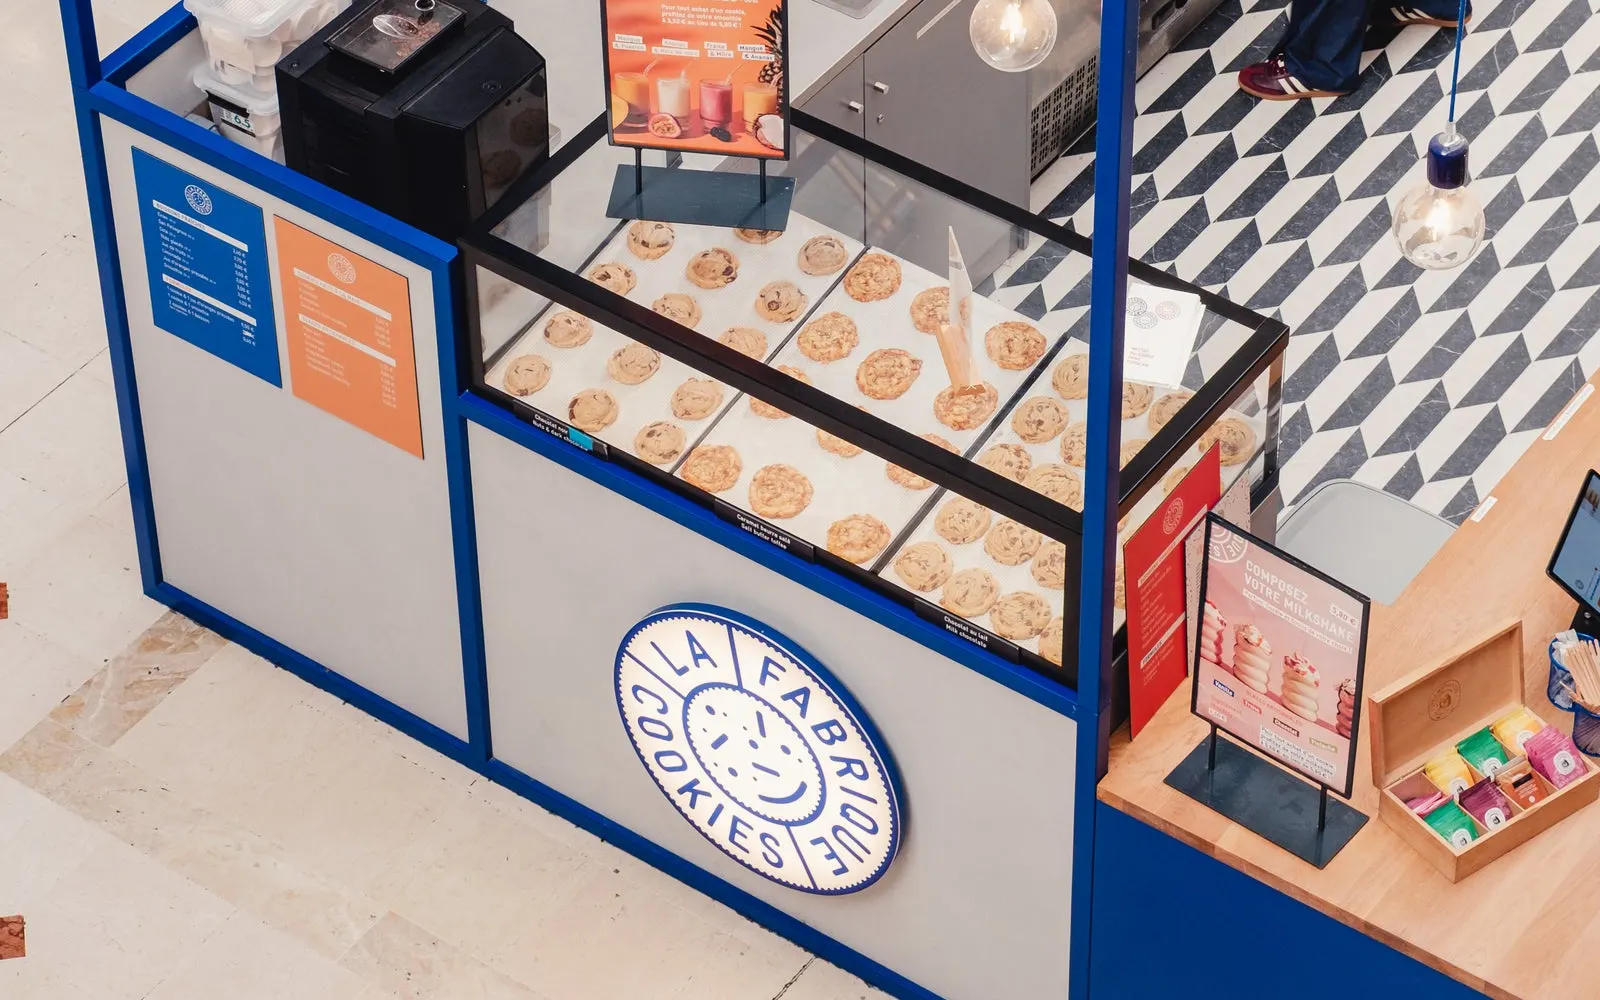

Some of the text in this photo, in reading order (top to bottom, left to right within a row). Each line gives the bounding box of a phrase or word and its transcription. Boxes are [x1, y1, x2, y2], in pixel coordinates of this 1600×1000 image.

[736, 513, 759, 529] Caramel
[760, 525, 778, 538] beurre
[741, 523, 787, 549] Salt butter toffee
[1245, 559, 1309, 605] COMPOSEZ
[1244, 573, 1281, 606] VOTRE
[1284, 589, 1354, 643] MILKSHAKE
[944, 615, 969, 632] Chocolat
[978, 632, 988, 642] lait
[946, 624, 987, 649] Milk chocolate
[650, 630, 717, 677] LA
[1215, 680, 1233, 697] Vanille
[1274, 719, 1297, 736] Chocolat
[632, 684, 784, 869] COOKIES
[759, 656, 878, 877] FABRIQUE
